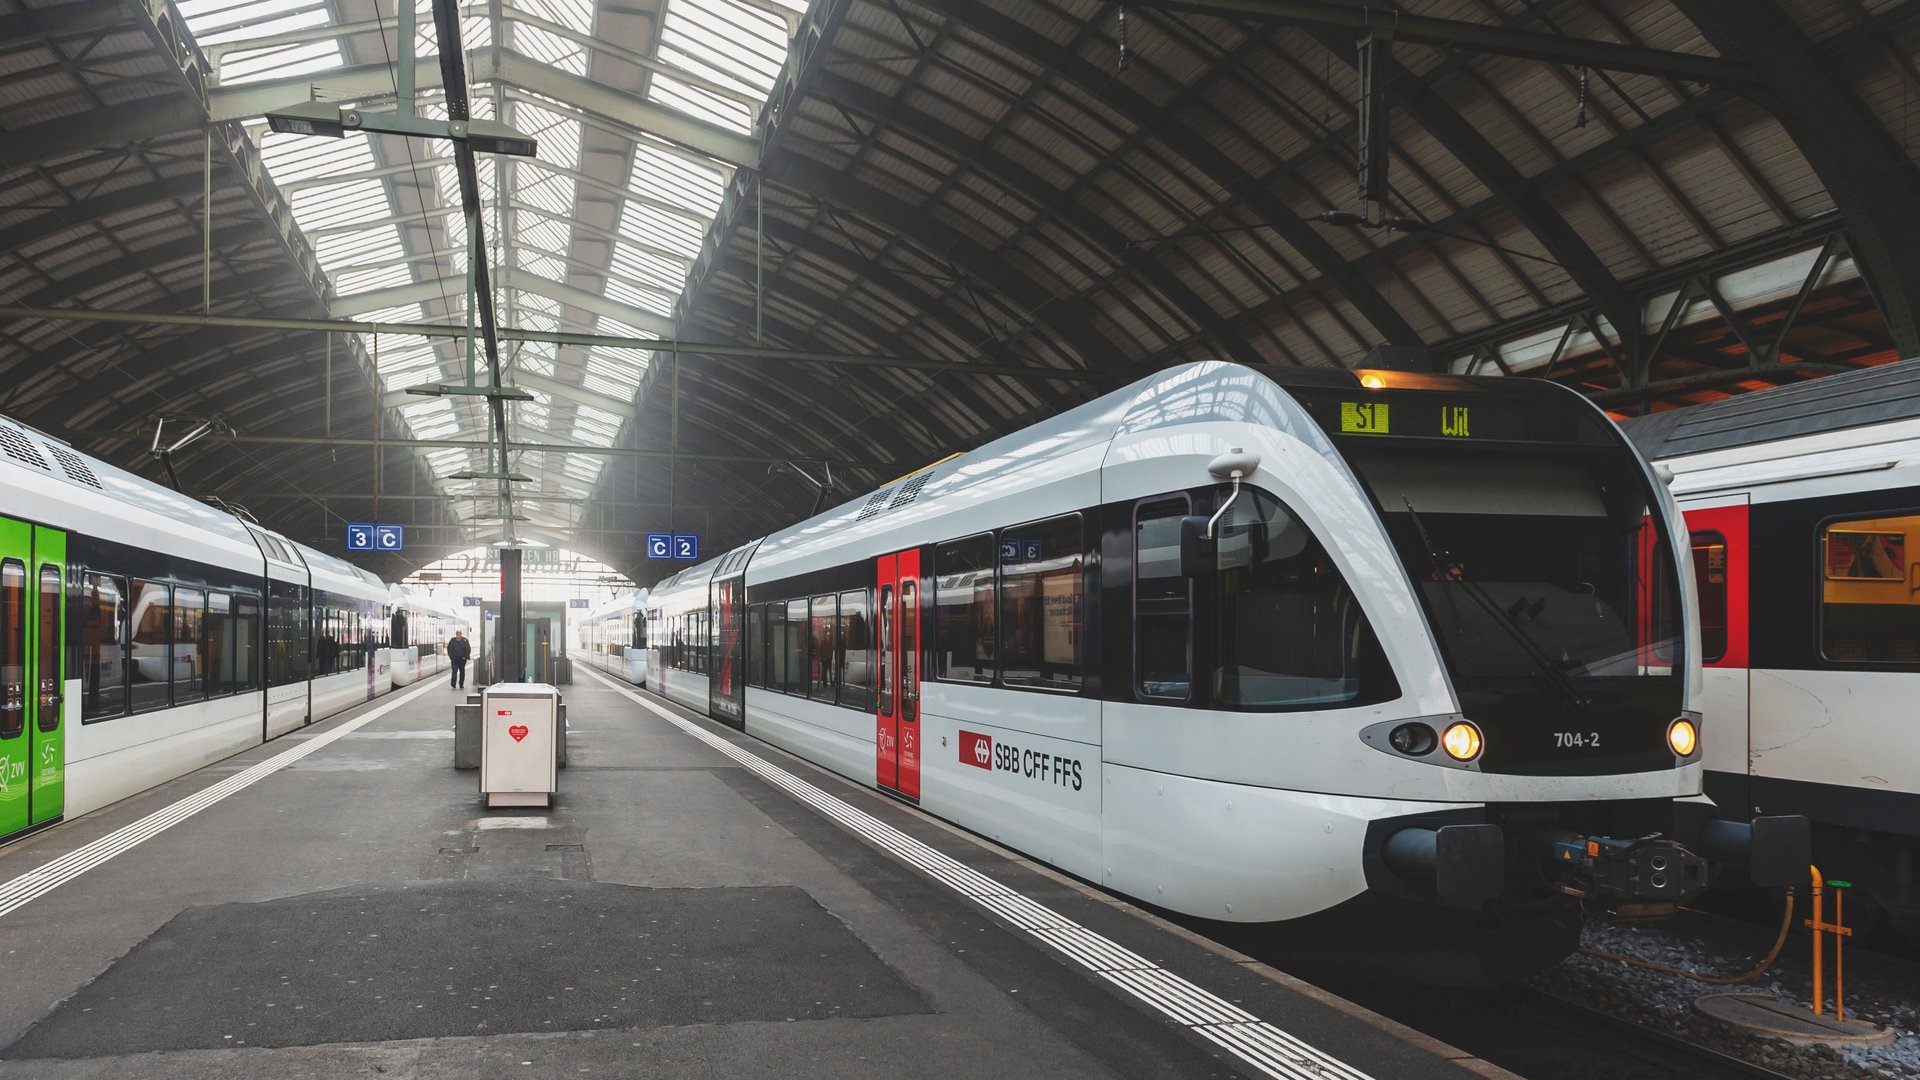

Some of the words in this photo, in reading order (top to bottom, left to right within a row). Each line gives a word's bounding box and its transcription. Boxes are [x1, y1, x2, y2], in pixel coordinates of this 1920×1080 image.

[1356, 403, 1376, 430] S1
[1442, 406, 1470, 436] Wil
[355, 532, 367, 547] 3
[382, 532, 396, 548] C
[545, 550, 560, 562] HB
[653, 541, 666, 556] C
[680, 542, 691, 556] 2
[1554, 732, 1600, 748] 704-2
[995, 742, 1020, 774] SBB
[1023, 749, 1050, 781] CFF
[1053, 756, 1083, 792] FFS
